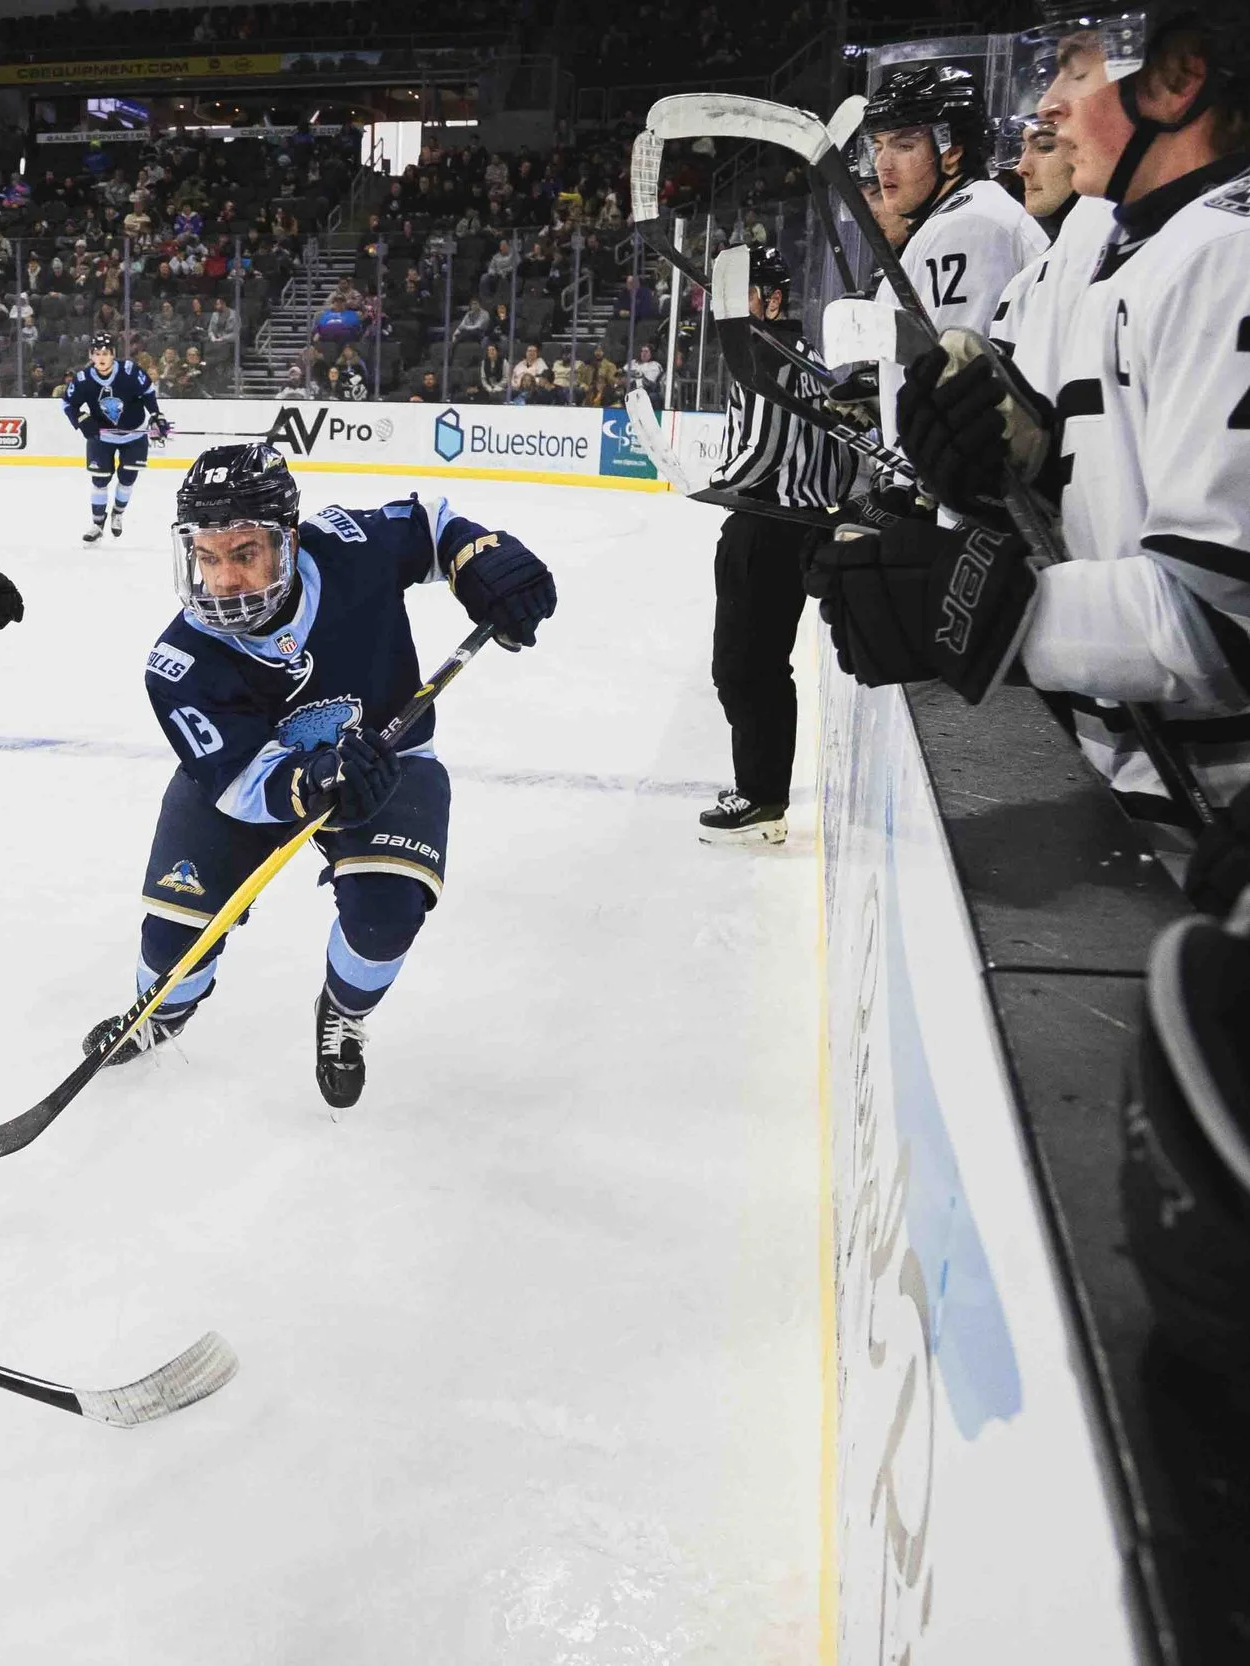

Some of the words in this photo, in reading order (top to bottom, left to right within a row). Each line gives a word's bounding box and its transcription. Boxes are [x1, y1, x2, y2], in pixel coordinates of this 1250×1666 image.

[925, 252, 968, 308] 12
[1114, 298, 1131, 387] C
[329, 418, 372, 441] Pro
[470, 425, 589, 459] Bluestone
[204, 466, 229, 485] 13
[169, 706, 224, 759] 13
